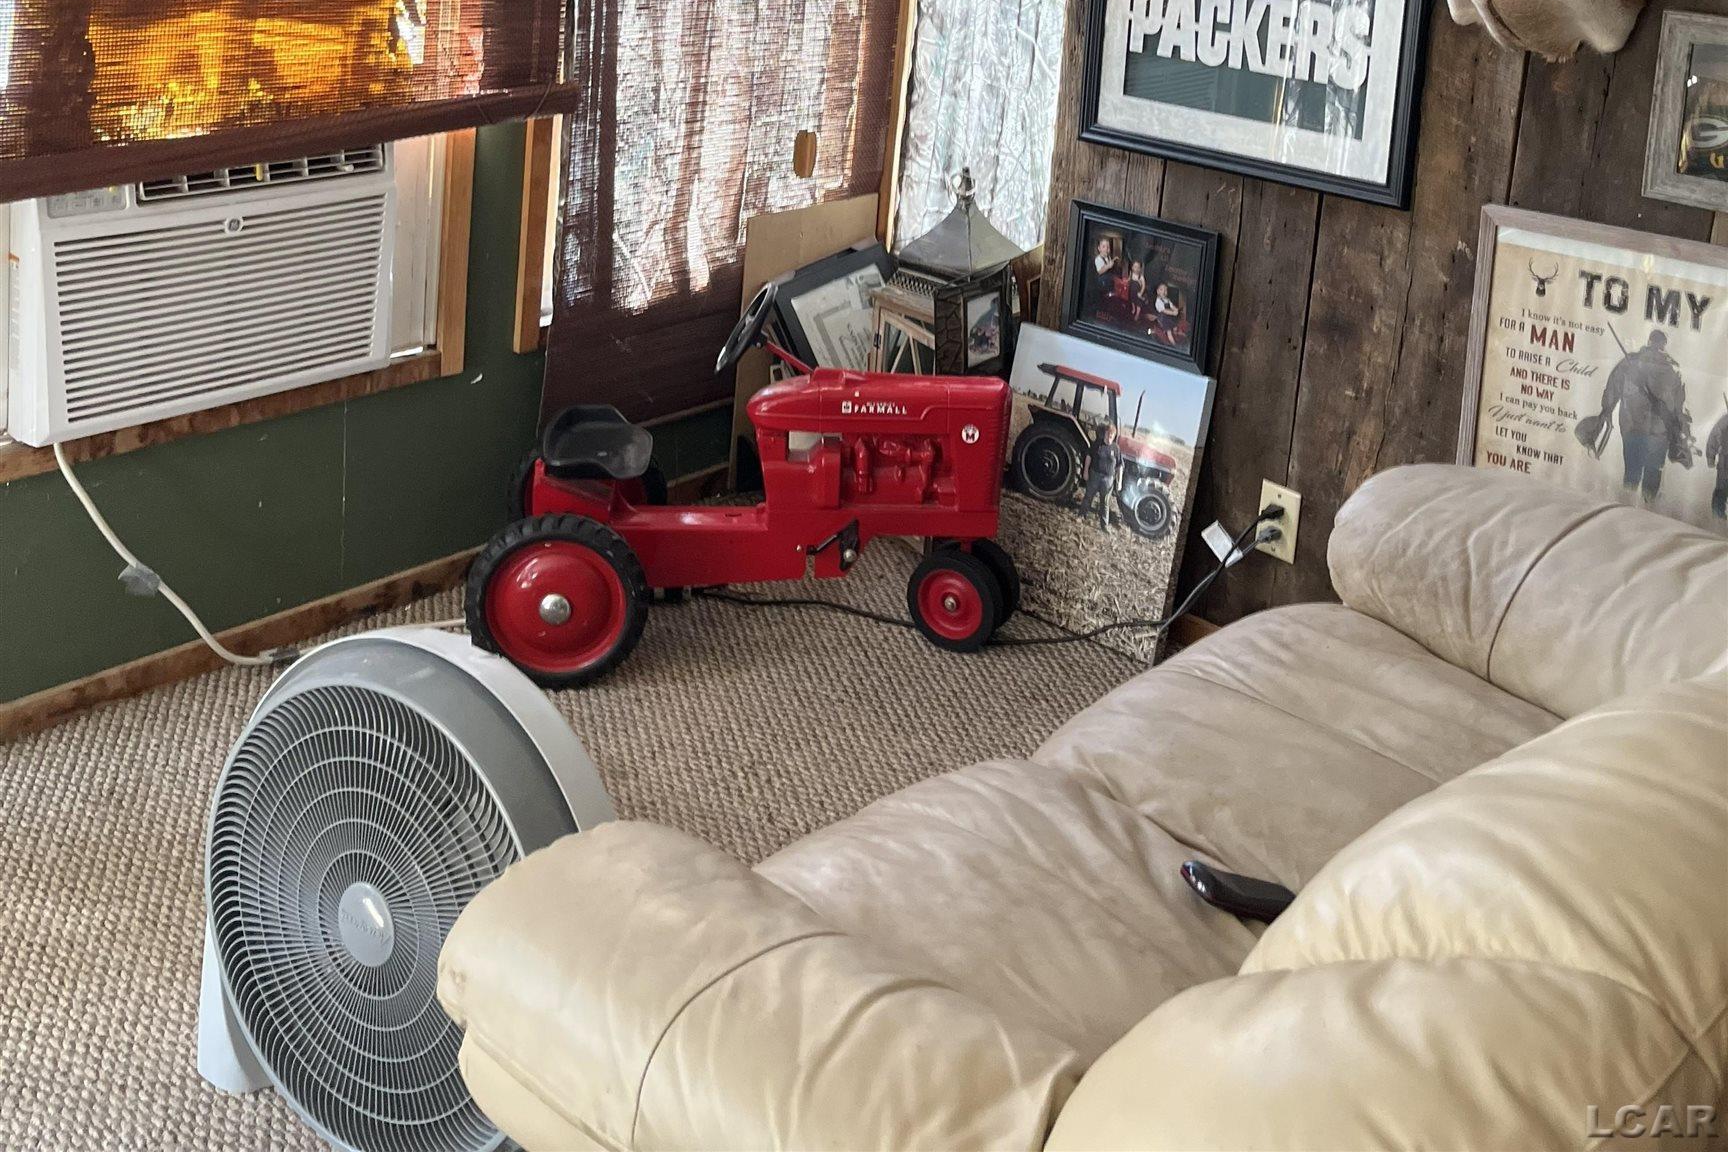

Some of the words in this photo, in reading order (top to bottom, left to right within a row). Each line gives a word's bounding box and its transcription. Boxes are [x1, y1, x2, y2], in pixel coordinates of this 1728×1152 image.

[1579, 268, 1629, 315] TO
[1644, 283, 1711, 332] MY
[1521, 308, 1526, 318] I
[1528, 308, 1551, 323] know
[1553, 315, 1566, 327] it's
[1568, 320, 1583, 330] not
[1585, 324, 1605, 336] easy
[1499, 316, 1517, 331] FOR
[1518, 321, 1525, 333] A
[1529, 323, 1576, 353] MAN
[1505, 346, 1516, 359] TO
[1518, 349, 1543, 365] RAISE
[1545, 356, 1551, 367] A
[1556, 358, 1600, 377] Child
[1509, 366, 1528, 380] AND
[1530, 370, 1559, 388] THERE
[1561, 378, 1571, 391] IS
[1520, 383, 1533, 397] NO
[1536, 387, 1555, 402] WAY
[854, 404, 908, 415] FARMALL
[1499, 392, 1504, 402] I
[1505, 395, 1520, 406] can
[1522, 400, 1538, 411] pay
[1540, 404, 1555, 415] you
[1558, 407, 1578, 420] back
[1495, 425, 1508, 439] LET
[1511, 430, 1527, 443] YOU
[1525, 417, 1556, 429] want
[1555, 422, 1567, 433] to
[1487, 450, 1507, 467] YOU
[1509, 458, 1532, 474] ARE
[1516, 444, 1541, 460] KNOW
[1543, 451, 1564, 465] THAT
